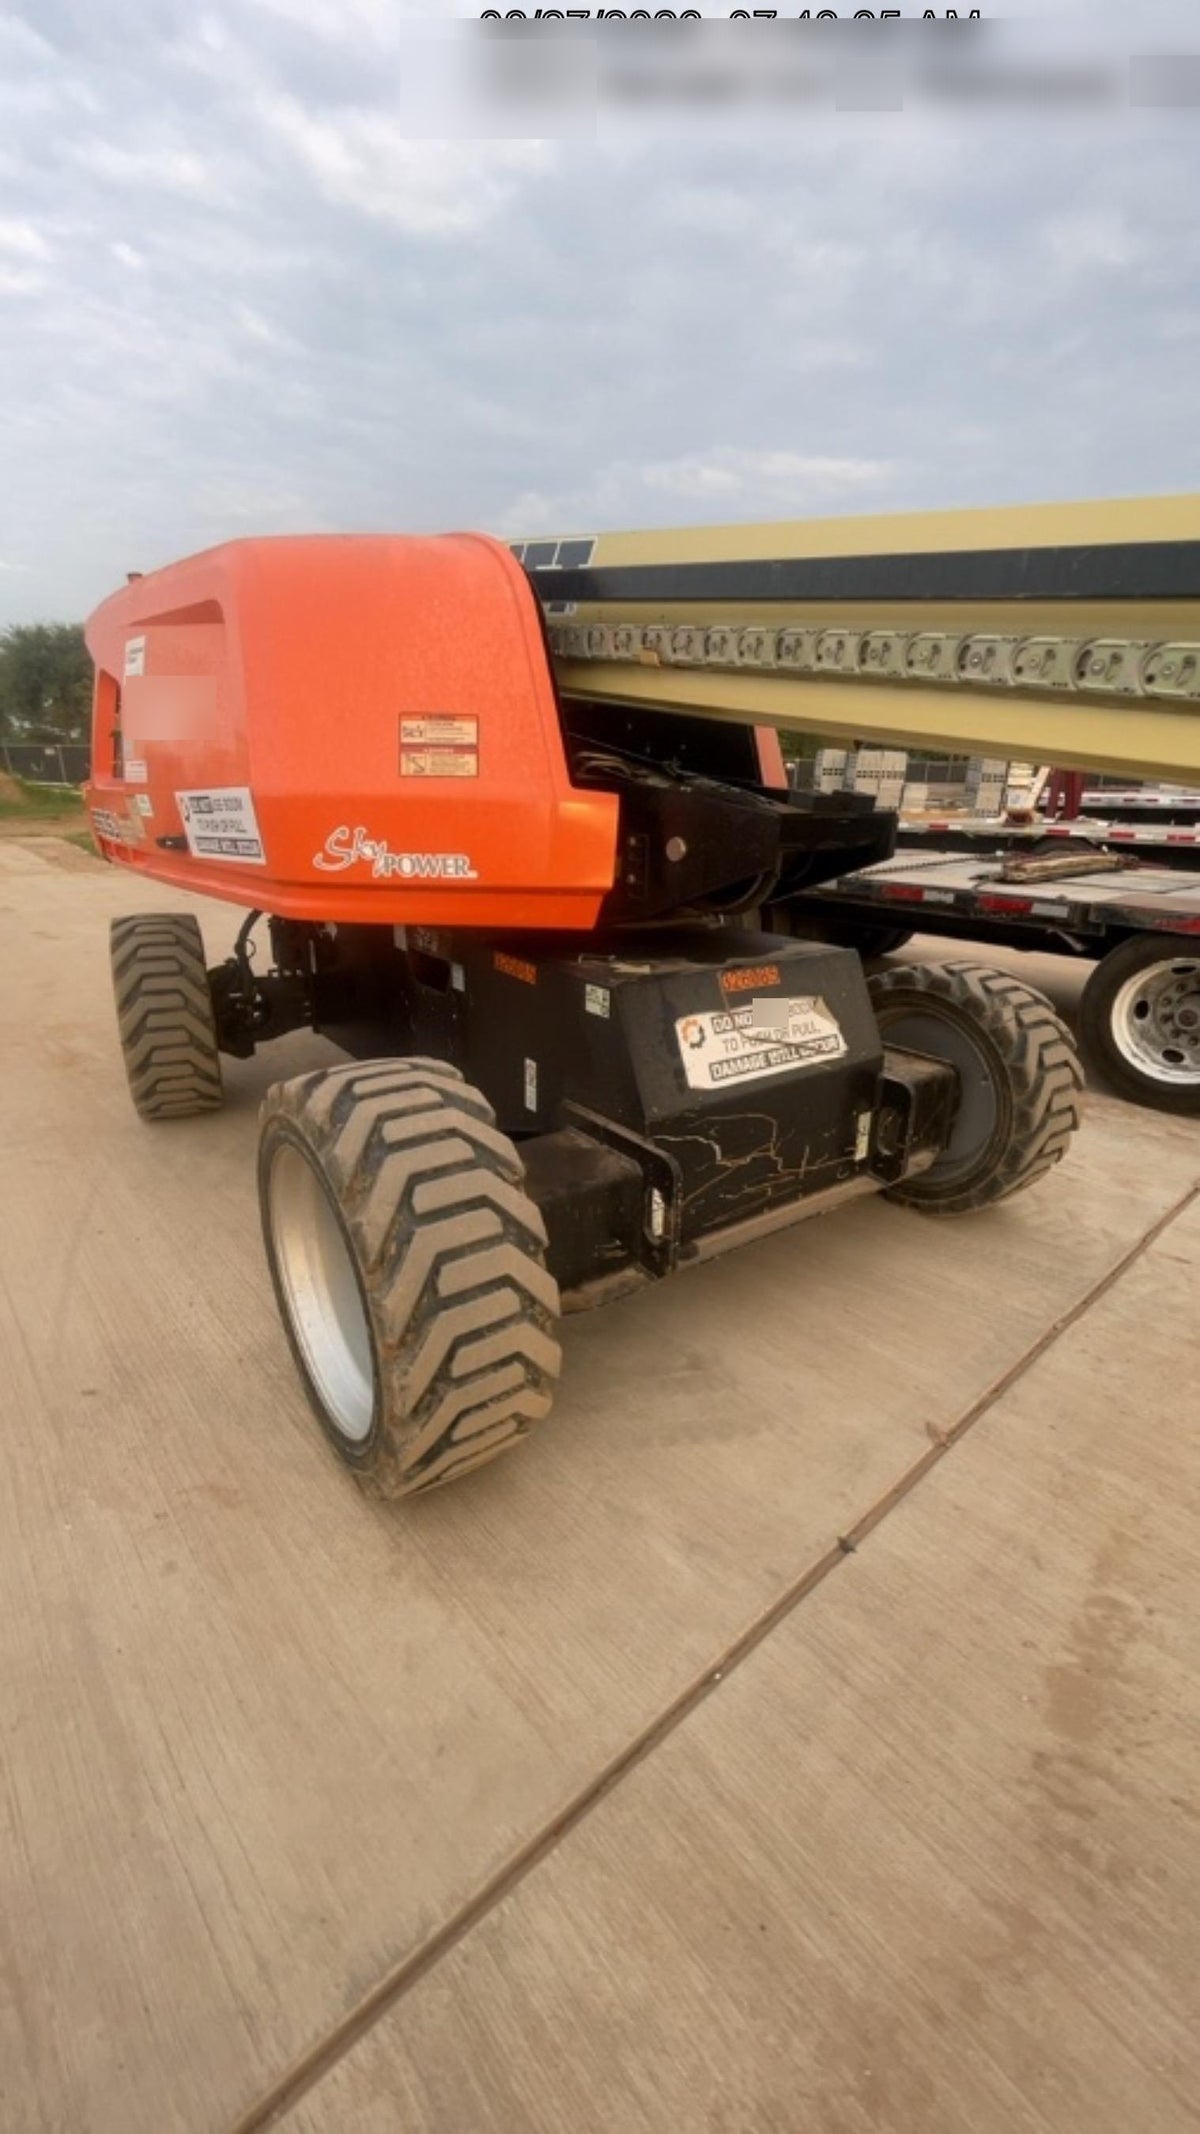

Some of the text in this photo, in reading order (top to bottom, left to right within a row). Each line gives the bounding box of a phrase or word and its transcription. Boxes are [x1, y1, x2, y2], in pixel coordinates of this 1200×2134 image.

[381, 853, 471, 879] POWER
[713, 1015, 733, 1033] DO
[722, 1038, 738, 1053] TO
[711, 1051, 766, 1079] DAMAGE
